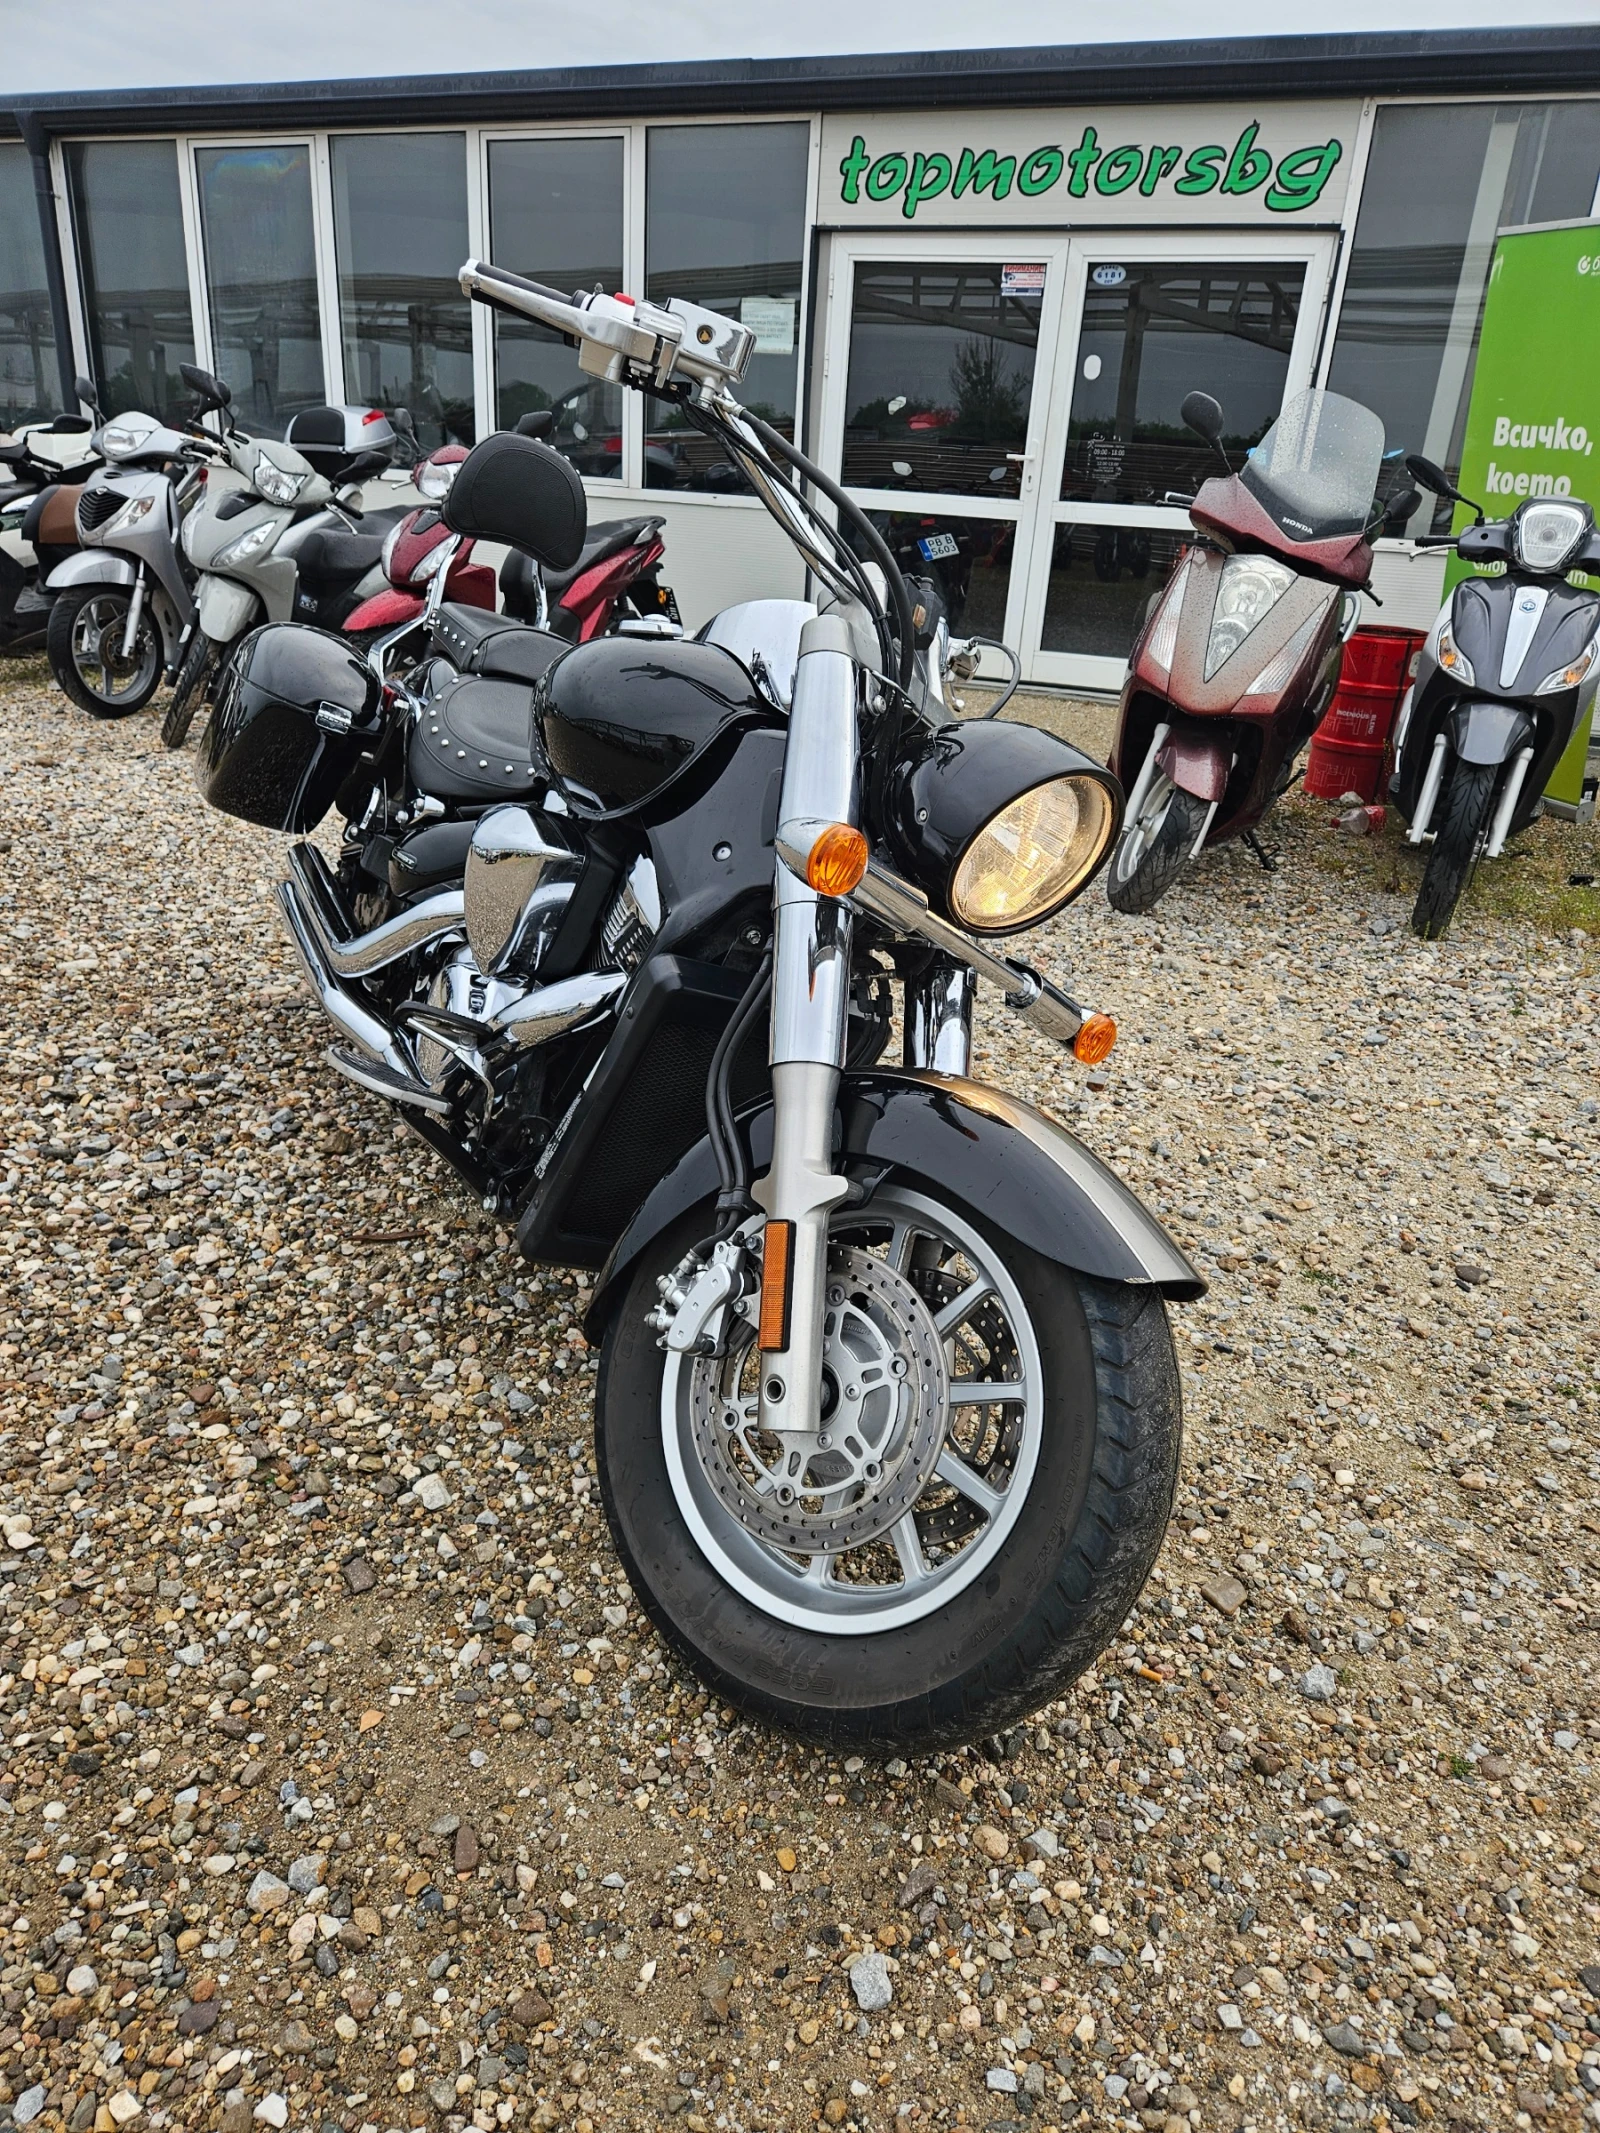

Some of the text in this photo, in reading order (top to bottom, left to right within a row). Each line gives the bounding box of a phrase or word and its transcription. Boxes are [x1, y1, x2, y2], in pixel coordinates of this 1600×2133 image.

[840, 119, 1343, 219] topmotorsbg
[1493, 416, 1594, 456] Всичко,
[1485, 462, 1572, 497] което
[1282, 516, 1314, 534] HONDA
[931, 545, 956, 556] 5603
